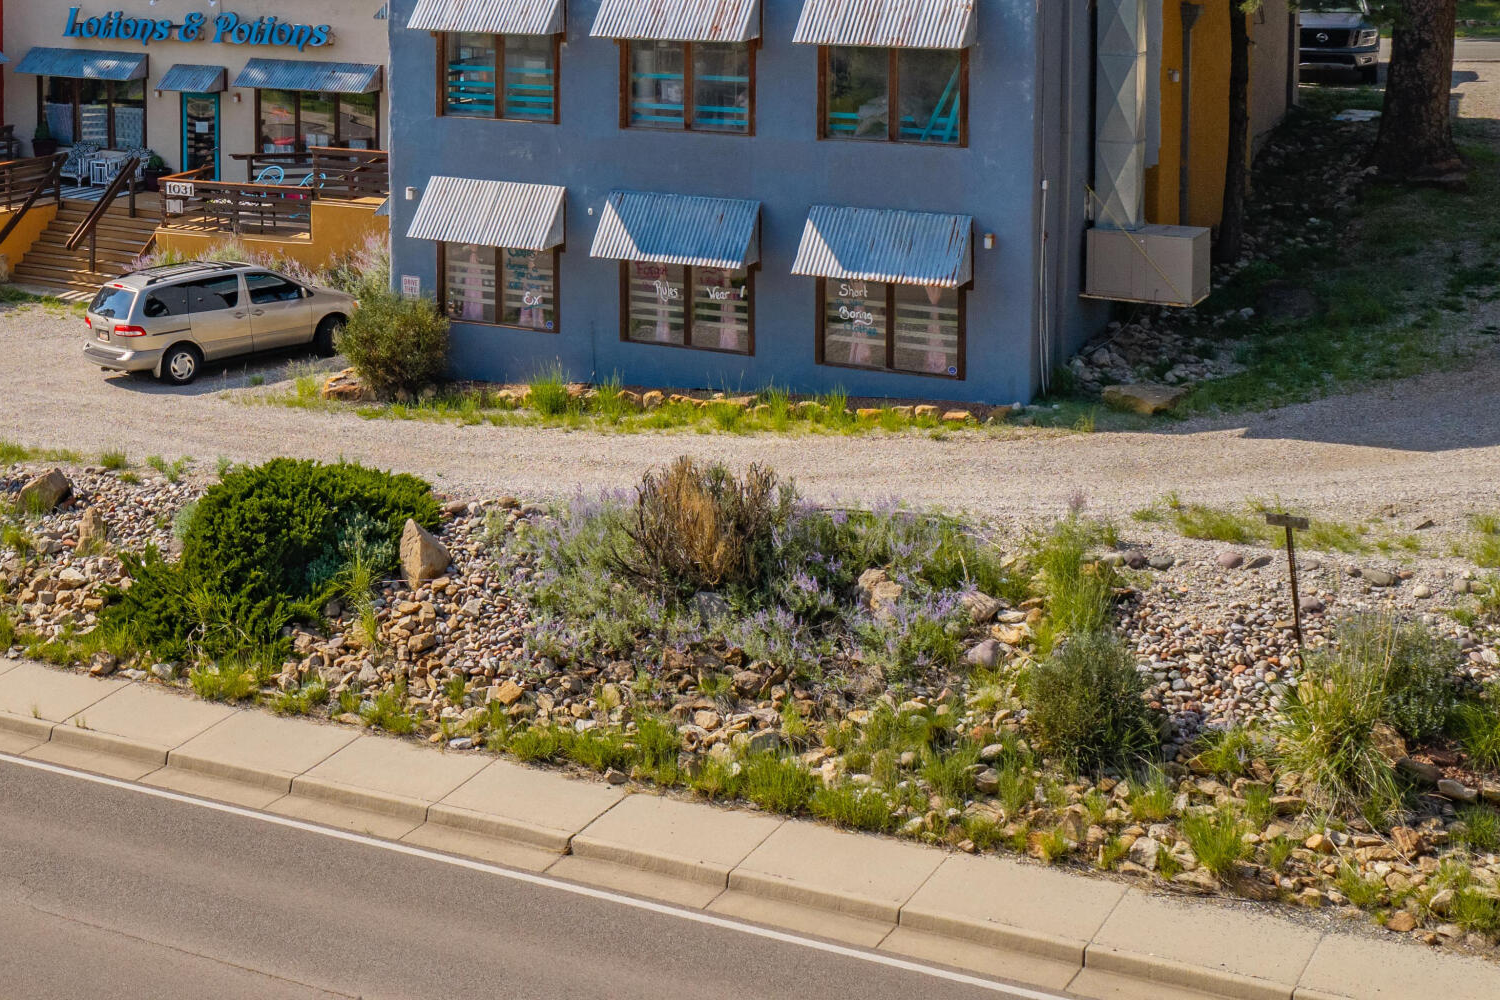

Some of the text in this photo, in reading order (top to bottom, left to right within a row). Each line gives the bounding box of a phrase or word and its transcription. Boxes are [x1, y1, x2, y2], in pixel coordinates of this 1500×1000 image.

[62, 7, 335, 52] Lotions & Potions
[168, 184, 194, 196] 1031
[652, 279, 679, 302] Rules
[706, 285, 731, 300] Wear
[838, 283, 869, 298] Short
[838, 305, 874, 326] Boring
